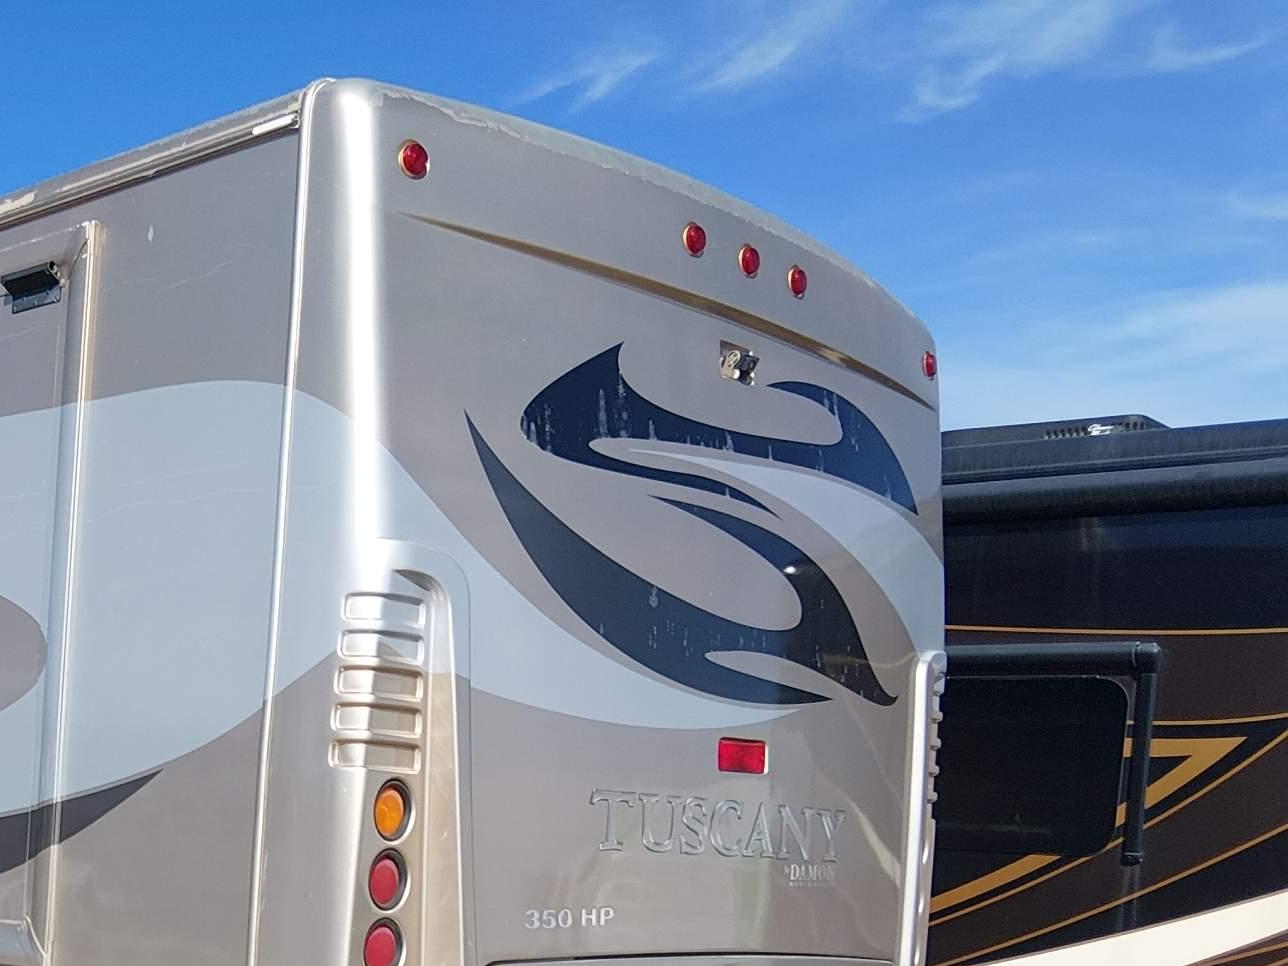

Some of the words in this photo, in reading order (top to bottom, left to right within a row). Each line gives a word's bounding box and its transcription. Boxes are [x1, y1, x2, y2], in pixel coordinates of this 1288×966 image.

[589, 788, 847, 862] TUSCANY
[524, 908, 573, 929] 350
[581, 907, 614, 927] HP
